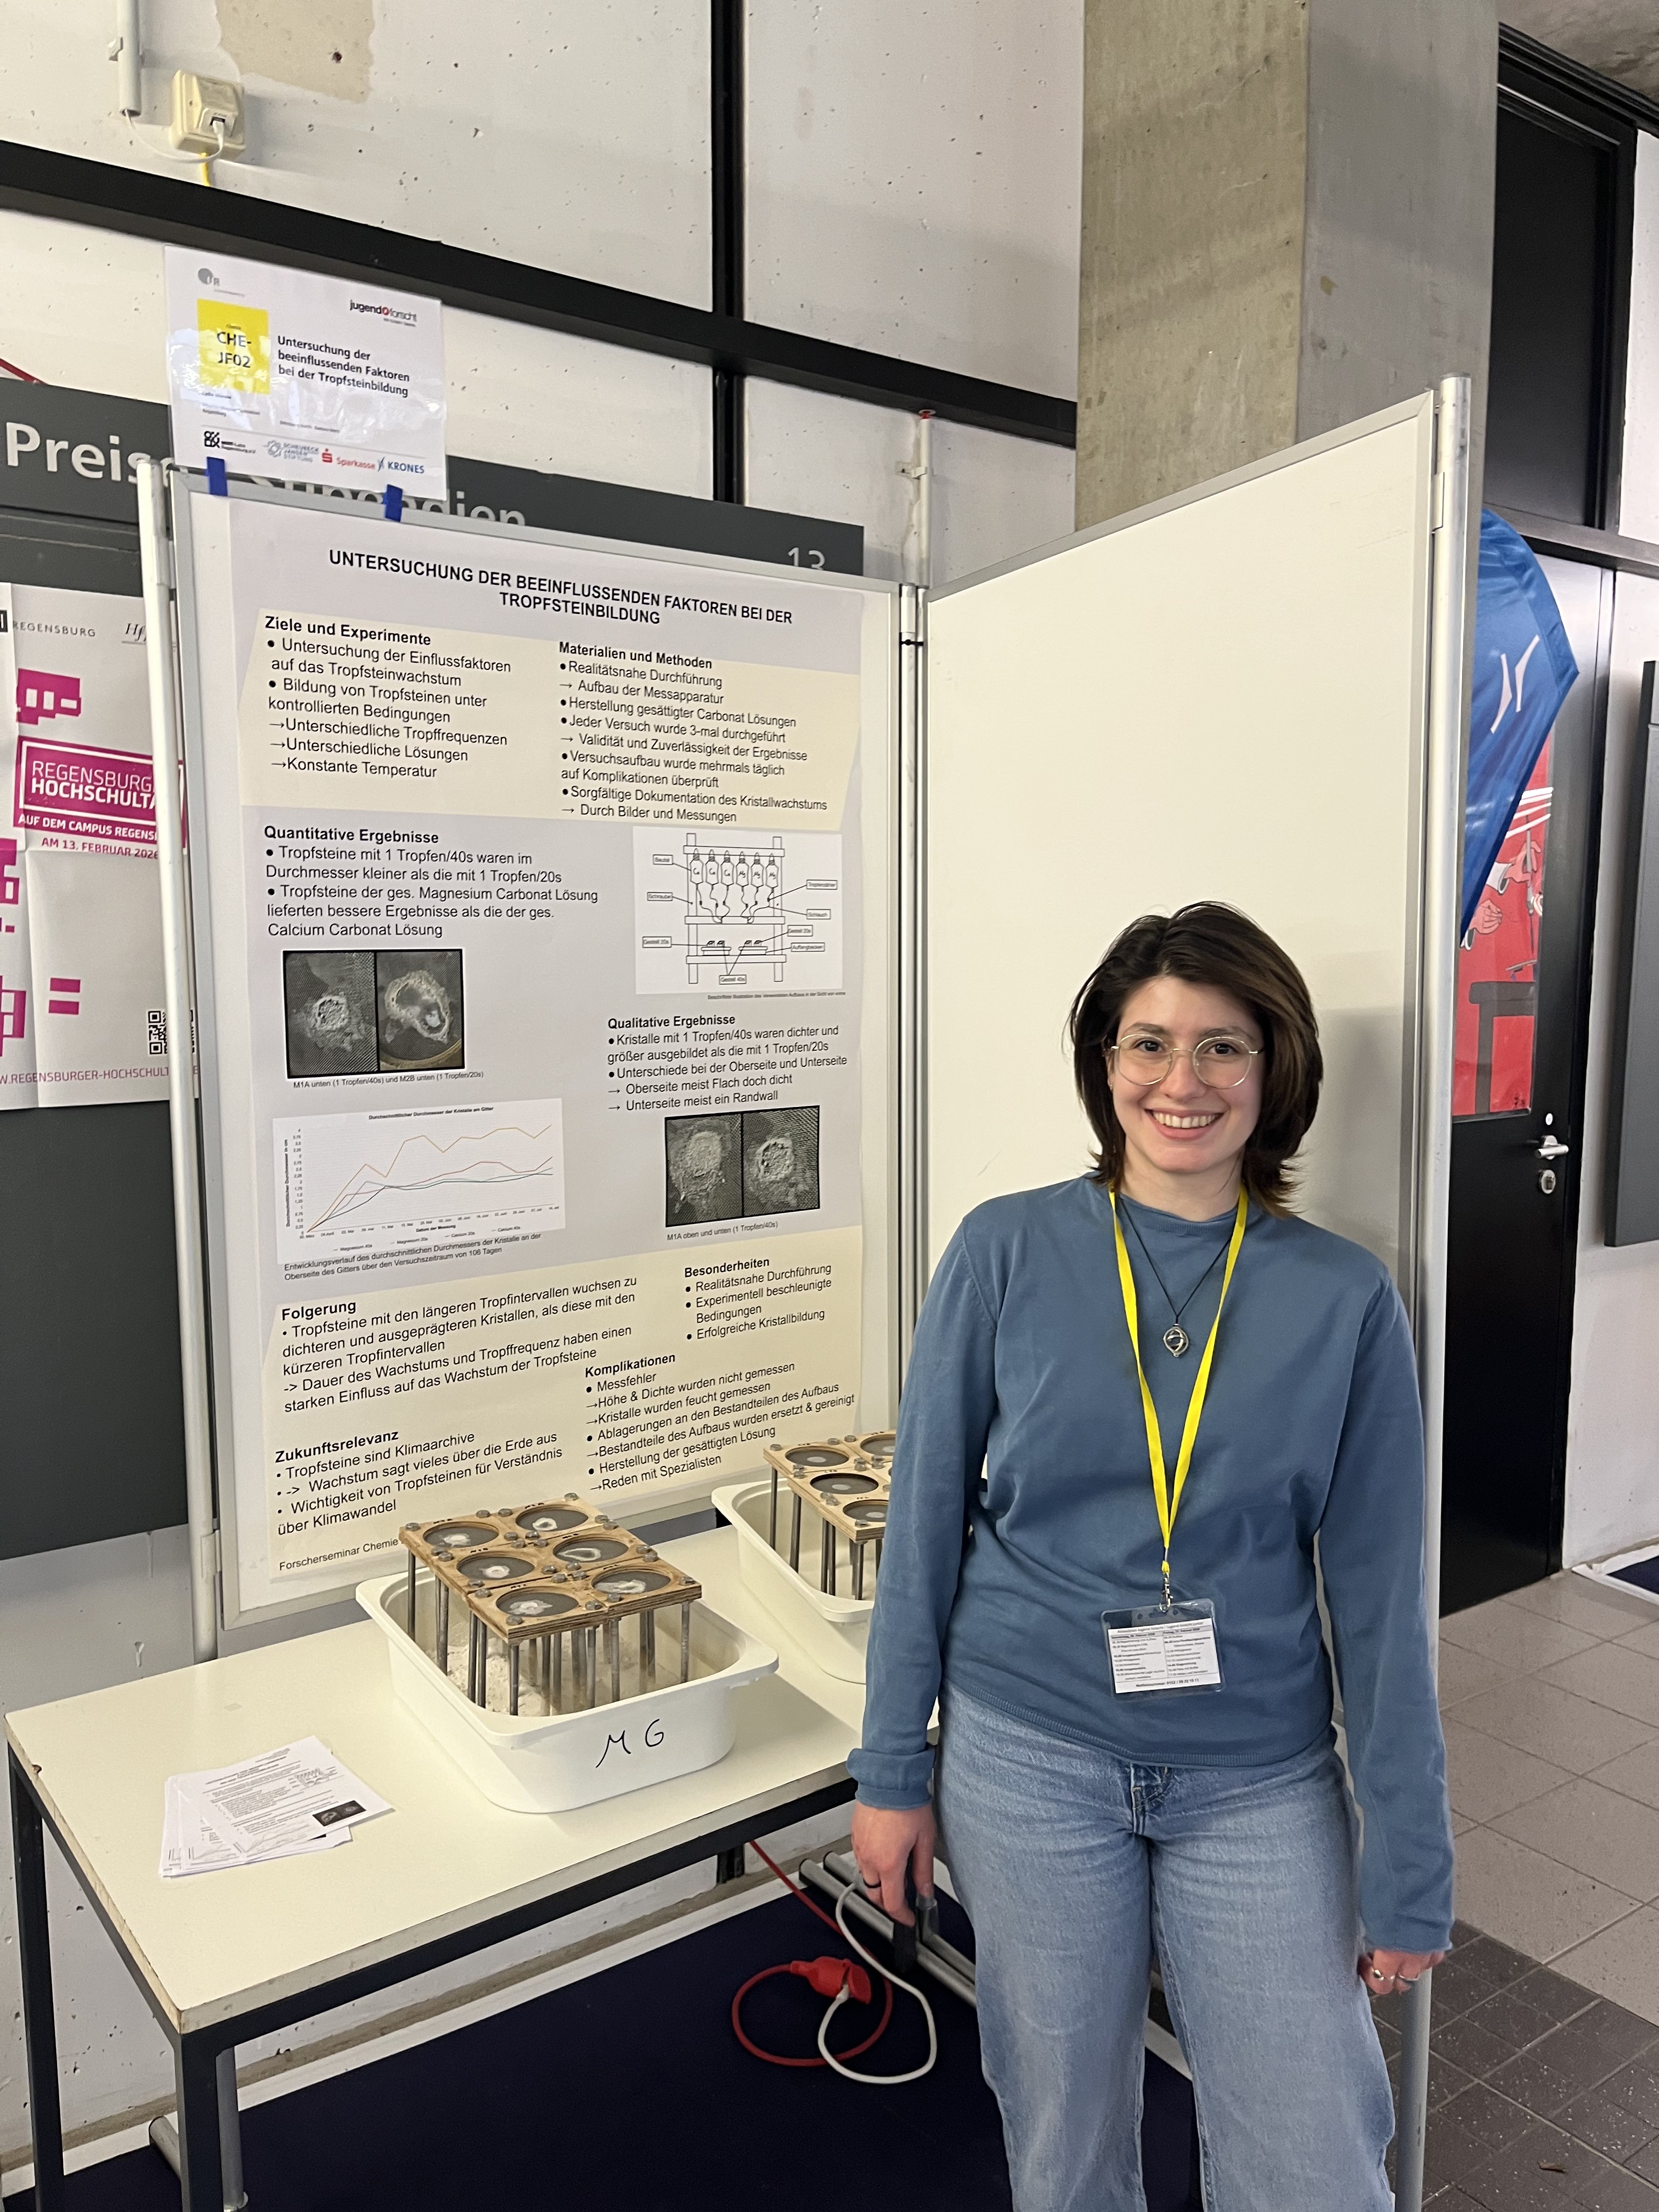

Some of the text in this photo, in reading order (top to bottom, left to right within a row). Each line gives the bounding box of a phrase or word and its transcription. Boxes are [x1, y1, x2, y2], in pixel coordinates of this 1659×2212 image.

[350, 299, 382, 314] jugend
[217, 331, 252, 347] CHE-
[278, 336, 370, 360] Untersuchung der
[218, 352, 251, 368] JF02
[279, 349, 409, 381] beeinflussenden Faktoren
[279, 364, 408, 398] bei der Tropfsteinbildung
[336, 456, 425, 474] Sparkasse KRONES
[330, 550, 792, 623] UNTERSUCHUNG DER BEEINFLUSSENDEN FAKTOREN BEI DER
[499, 592, 659, 624] TROPFSTEINBILDUNG
[13, 620, 95, 637] REGENSBURG
[266, 616, 430, 645] Ziele und Experimente
[283, 637, 510, 672] Untersuchung der Einflussfaktoren
[560, 642, 712, 669] Materialien und Methoden
[272, 658, 461, 686] auf das Tropfsteinwachstum
[569, 661, 722, 690] Realitätsnahe Durchführung
[284, 678, 487, 707] Bildung von Tropfsteinen unter
[578, 680, 724, 704] Aufbau der Messapparatur
[269, 696, 450, 724] kontrollierten Bedingungen
[569, 696, 795, 729] Herstellung gesättigter Carbonat Lösungen
[286, 718, 507, 745] Unterschiedliche Tropffrequenzen
[287, 737, 467, 763] Unterschiedliche Lösungen
[287, 757, 437, 778] Konstante Temperatur
[561, 768, 719, 789] auf Komplikationen überprüft
[571, 786, 827, 810] Sorgfältige Dokumentation des Kristallwachstums
[18, 814, 157, 840] AUF DEM CAMPUS REGENS
[581, 804, 736, 824] Durch Bilder und Messungen
[42, 837, 59, 848] AM
[82, 843, 131, 856] FEBRUAR
[264, 826, 438, 844] Quantitative Ergebnisse
[280, 885, 597, 903] Tropfsteine der ges. Magnesium Carbonat Lösung
[268, 923, 442, 938] Calcium Carbonat Lösung
[608, 1015, 735, 1029] Qualitative Ergebnisse
[626, 1074, 792, 1094] Oberseite meist Flach doch dicht
[627, 1091, 777, 1110] Unterseite meist ein Randwall
[285, 1271, 320, 1280] Oberseite
[685, 1259, 769, 1277] Besonderheiten
[696, 1266, 831, 1292] Realitätsnahe Durchführung
[696, 1279, 831, 1308] Experimentell beschleunigte
[283, 1302, 356, 1321] Folgerung
[292, 1278, 636, 1337] Tropfsteine mit den längeren Tropfintervallen wuchsen zu
[697, 1306, 761, 1323] Bedingungen
[697, 1311, 825, 1339] Erfolgreiche Kristallbildung
[284, 1341, 444, 1375] kürzeren Tropfintervallen
[586, 1355, 675, 1378] Komplikationen
[597, 1373, 656, 1392] Messfehler
[597, 1384, 770, 1424] Kristalle wurden feucht gemessen
[275, 1432, 398, 1463] Zukunftsrelevanz
[285, 1434, 474, 1479] Tropfsteine sind Klimaarchive
[600, 1427, 775, 1474] Herstellung der gesättigten Lösung
[602, 1456, 721, 1489] Reden mit Spezialisten
[279, 1499, 396, 1535] über Klimawandel
[280, 1535, 399, 1571] Forscherseminar Chemie
